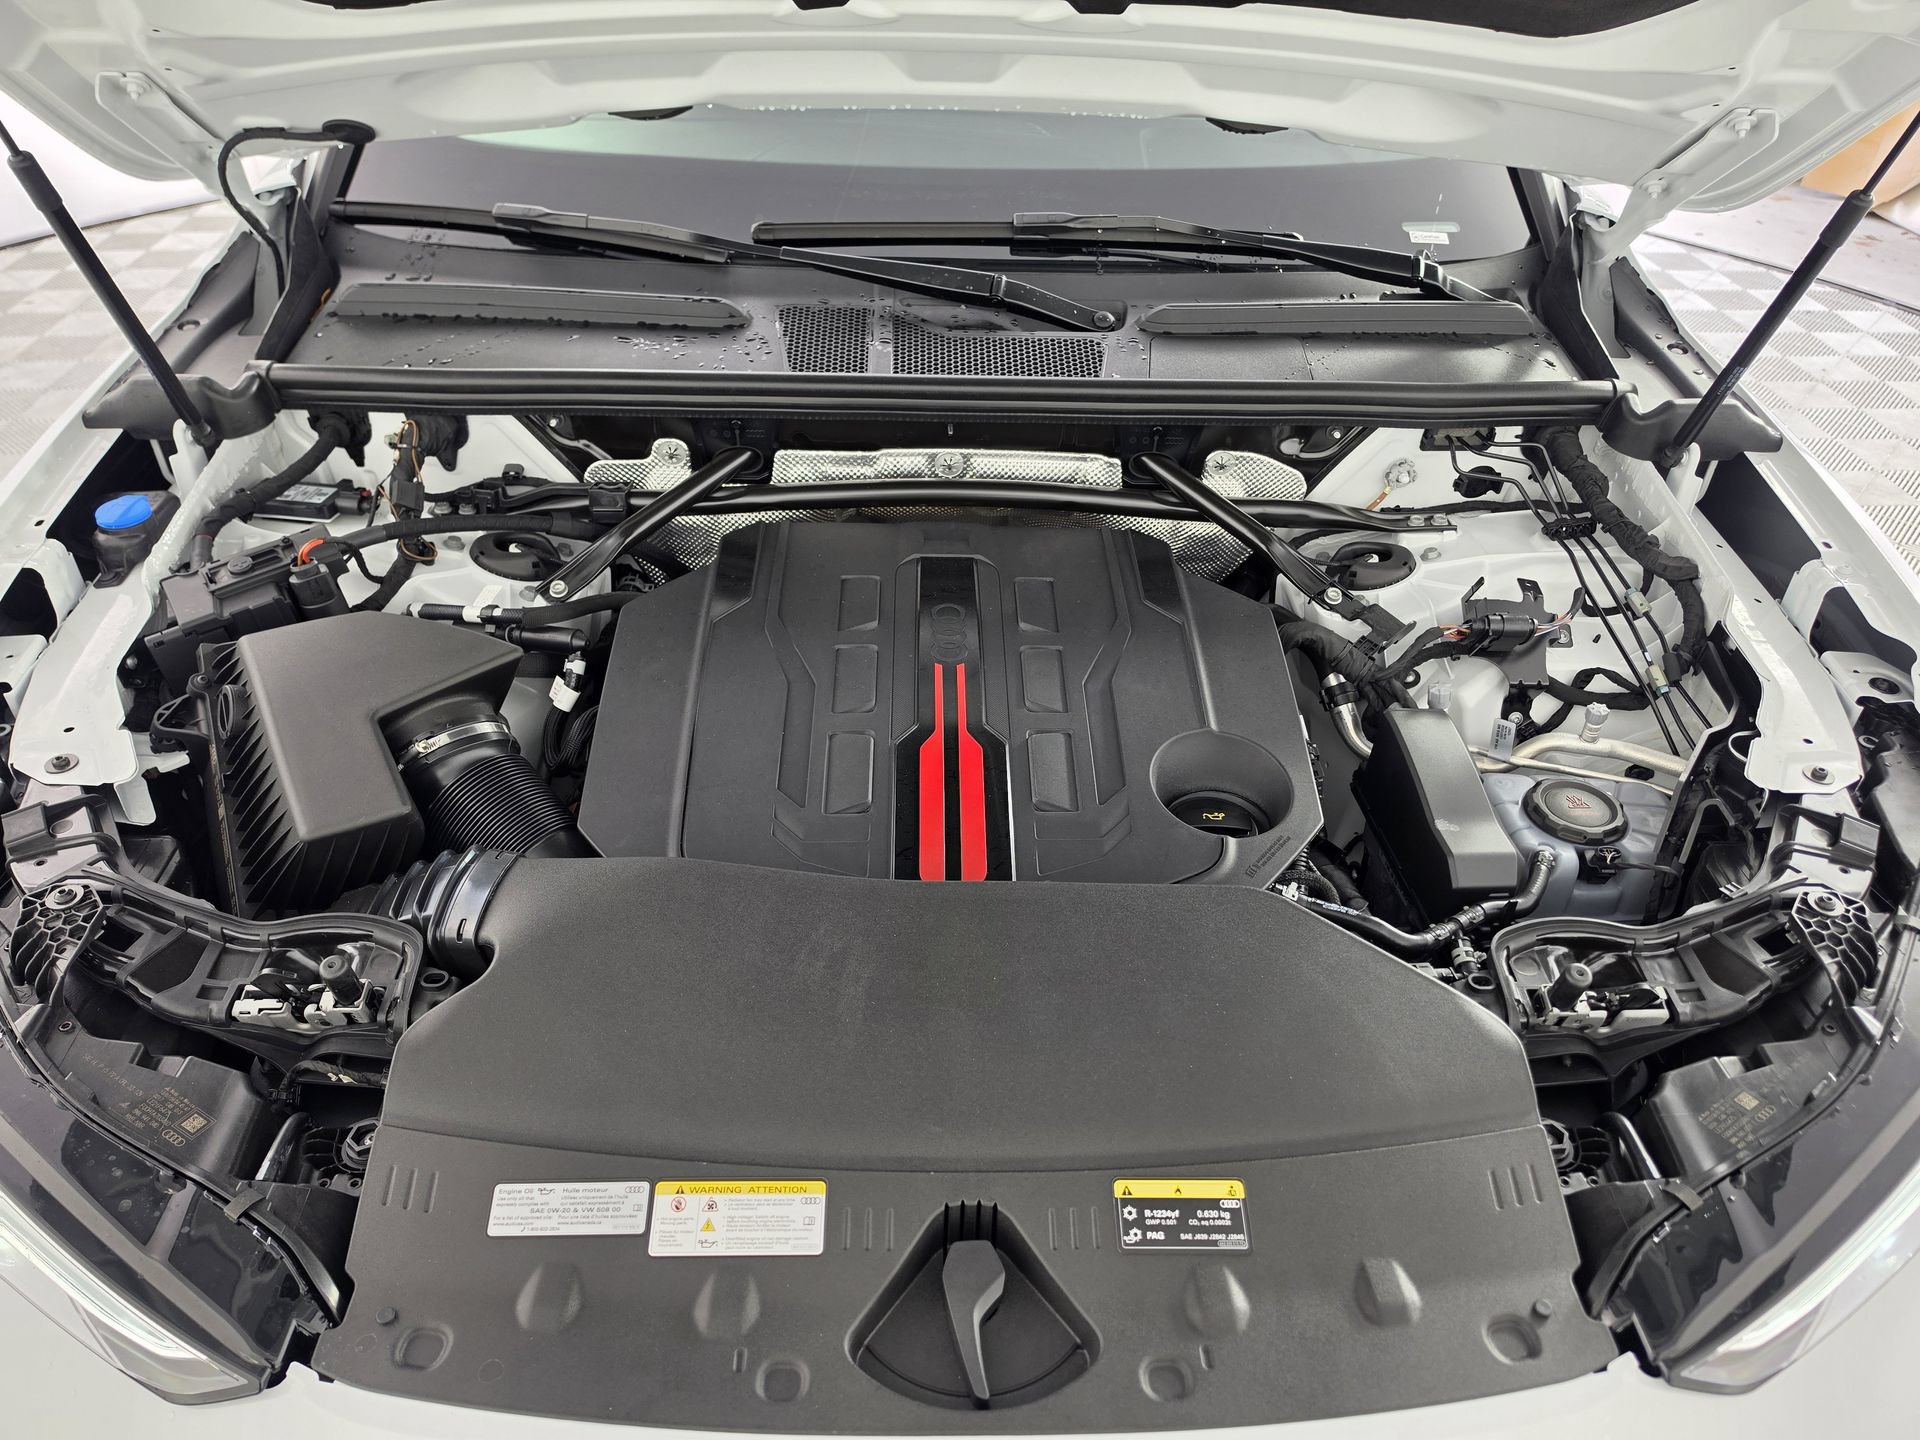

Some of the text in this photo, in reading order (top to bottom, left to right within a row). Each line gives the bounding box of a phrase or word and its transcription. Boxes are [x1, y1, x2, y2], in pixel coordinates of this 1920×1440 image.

[1144, 1209, 1231, 1220] R-1234yf 0.630 kg
[1146, 1231, 1165, 1240] PAG
